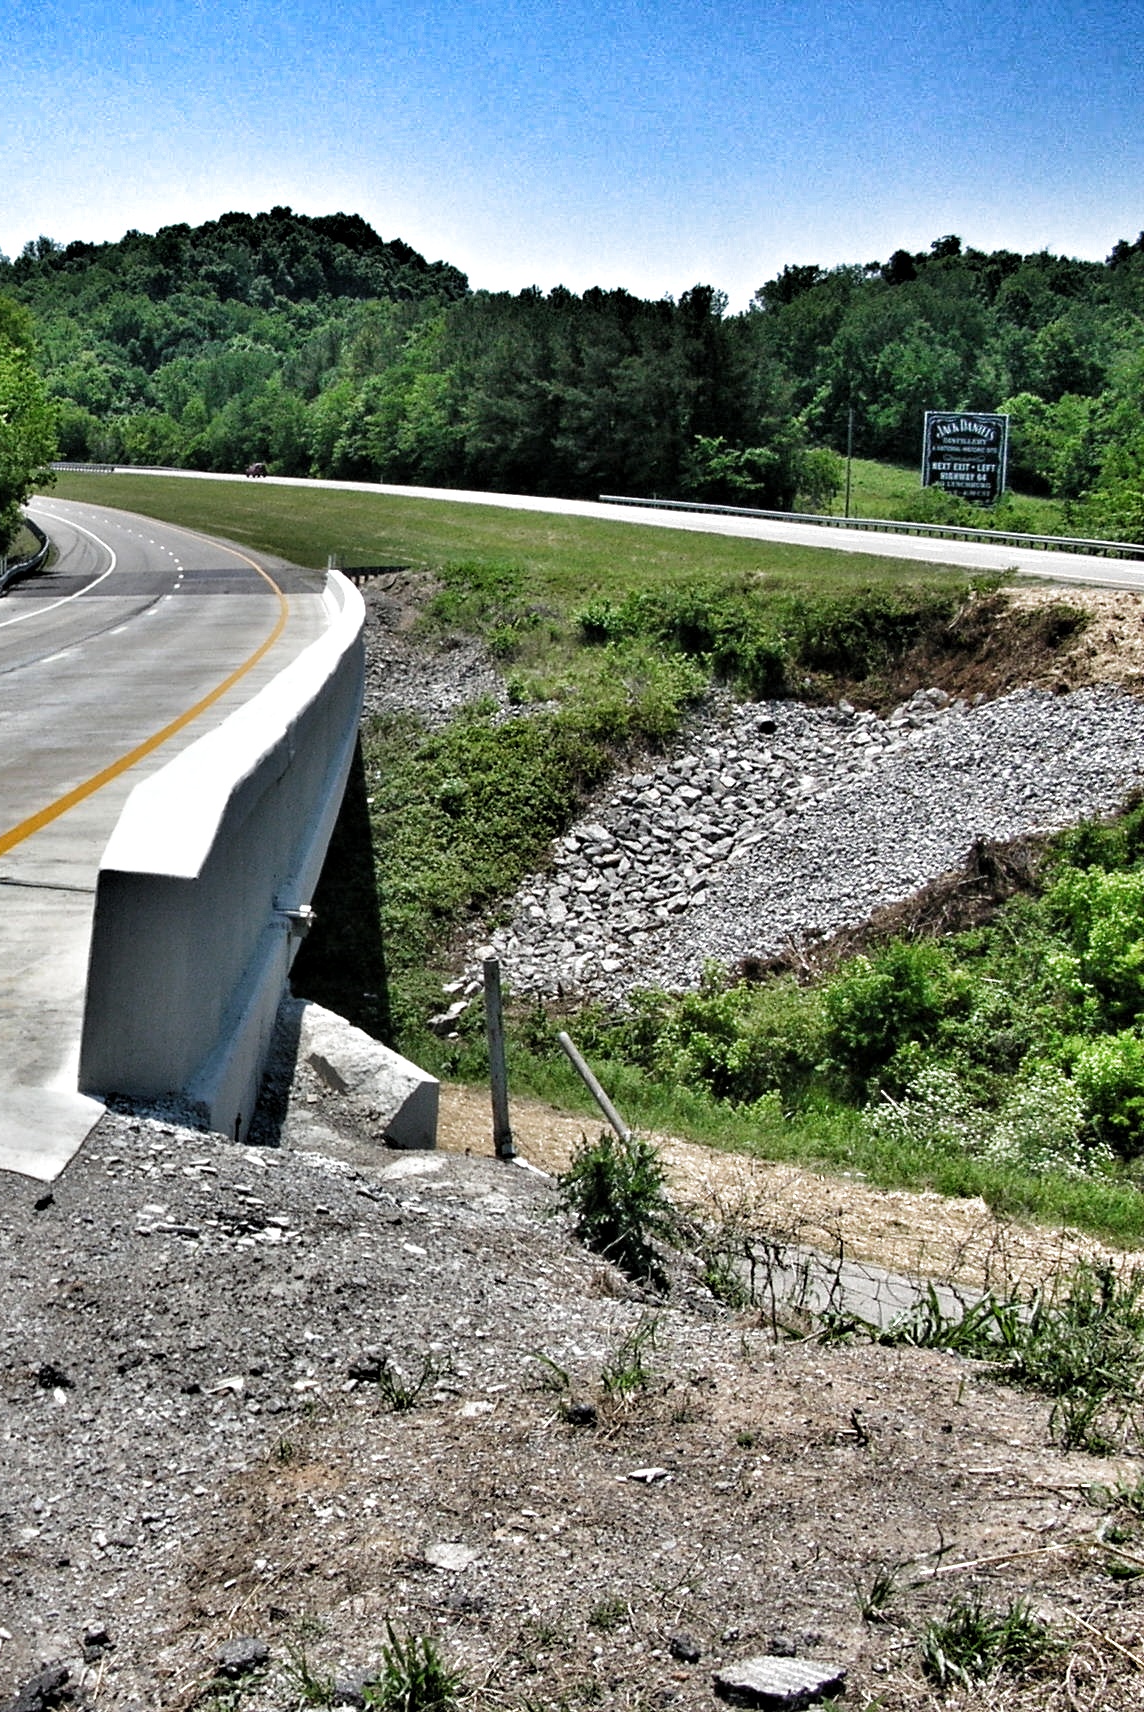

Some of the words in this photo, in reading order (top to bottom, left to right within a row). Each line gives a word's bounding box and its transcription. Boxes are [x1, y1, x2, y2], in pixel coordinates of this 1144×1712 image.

[936, 422, 959, 438] JACK
[932, 462, 951, 470] NEXT
[953, 462, 970, 471] EXIT
[977, 464, 996, 472] LEFT
[940, 472, 975, 481] HIGHWAY
[976, 473, 987, 481] 64
